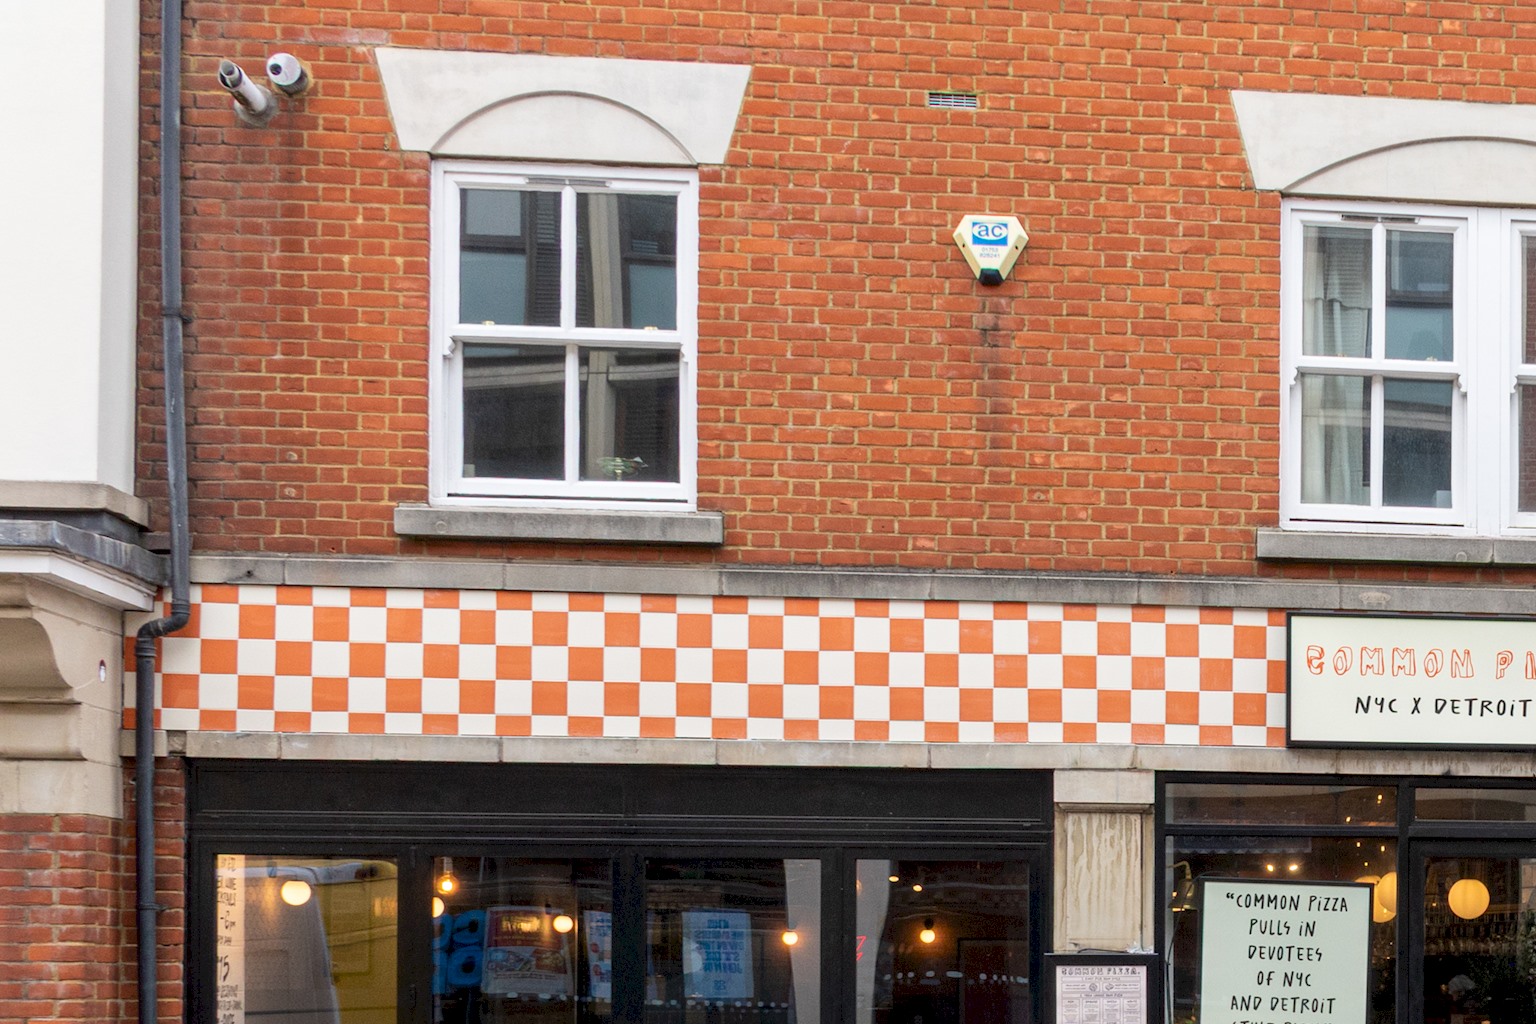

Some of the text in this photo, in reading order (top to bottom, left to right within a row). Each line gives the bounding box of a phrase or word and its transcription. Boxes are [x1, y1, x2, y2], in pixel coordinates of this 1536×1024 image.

[977, 224, 1003, 238] ac
[1306, 645, 1475, 679] COMMON
[1355, 695, 1397, 714] NYC
[1411, 697, 1421, 715] X
[1249, 918, 1290, 936] PULLS
[1248, 945, 1323, 962] DEVOTEES
[1256, 971, 1312, 987] OF NYC
[1230, 995, 1262, 1011] AND
